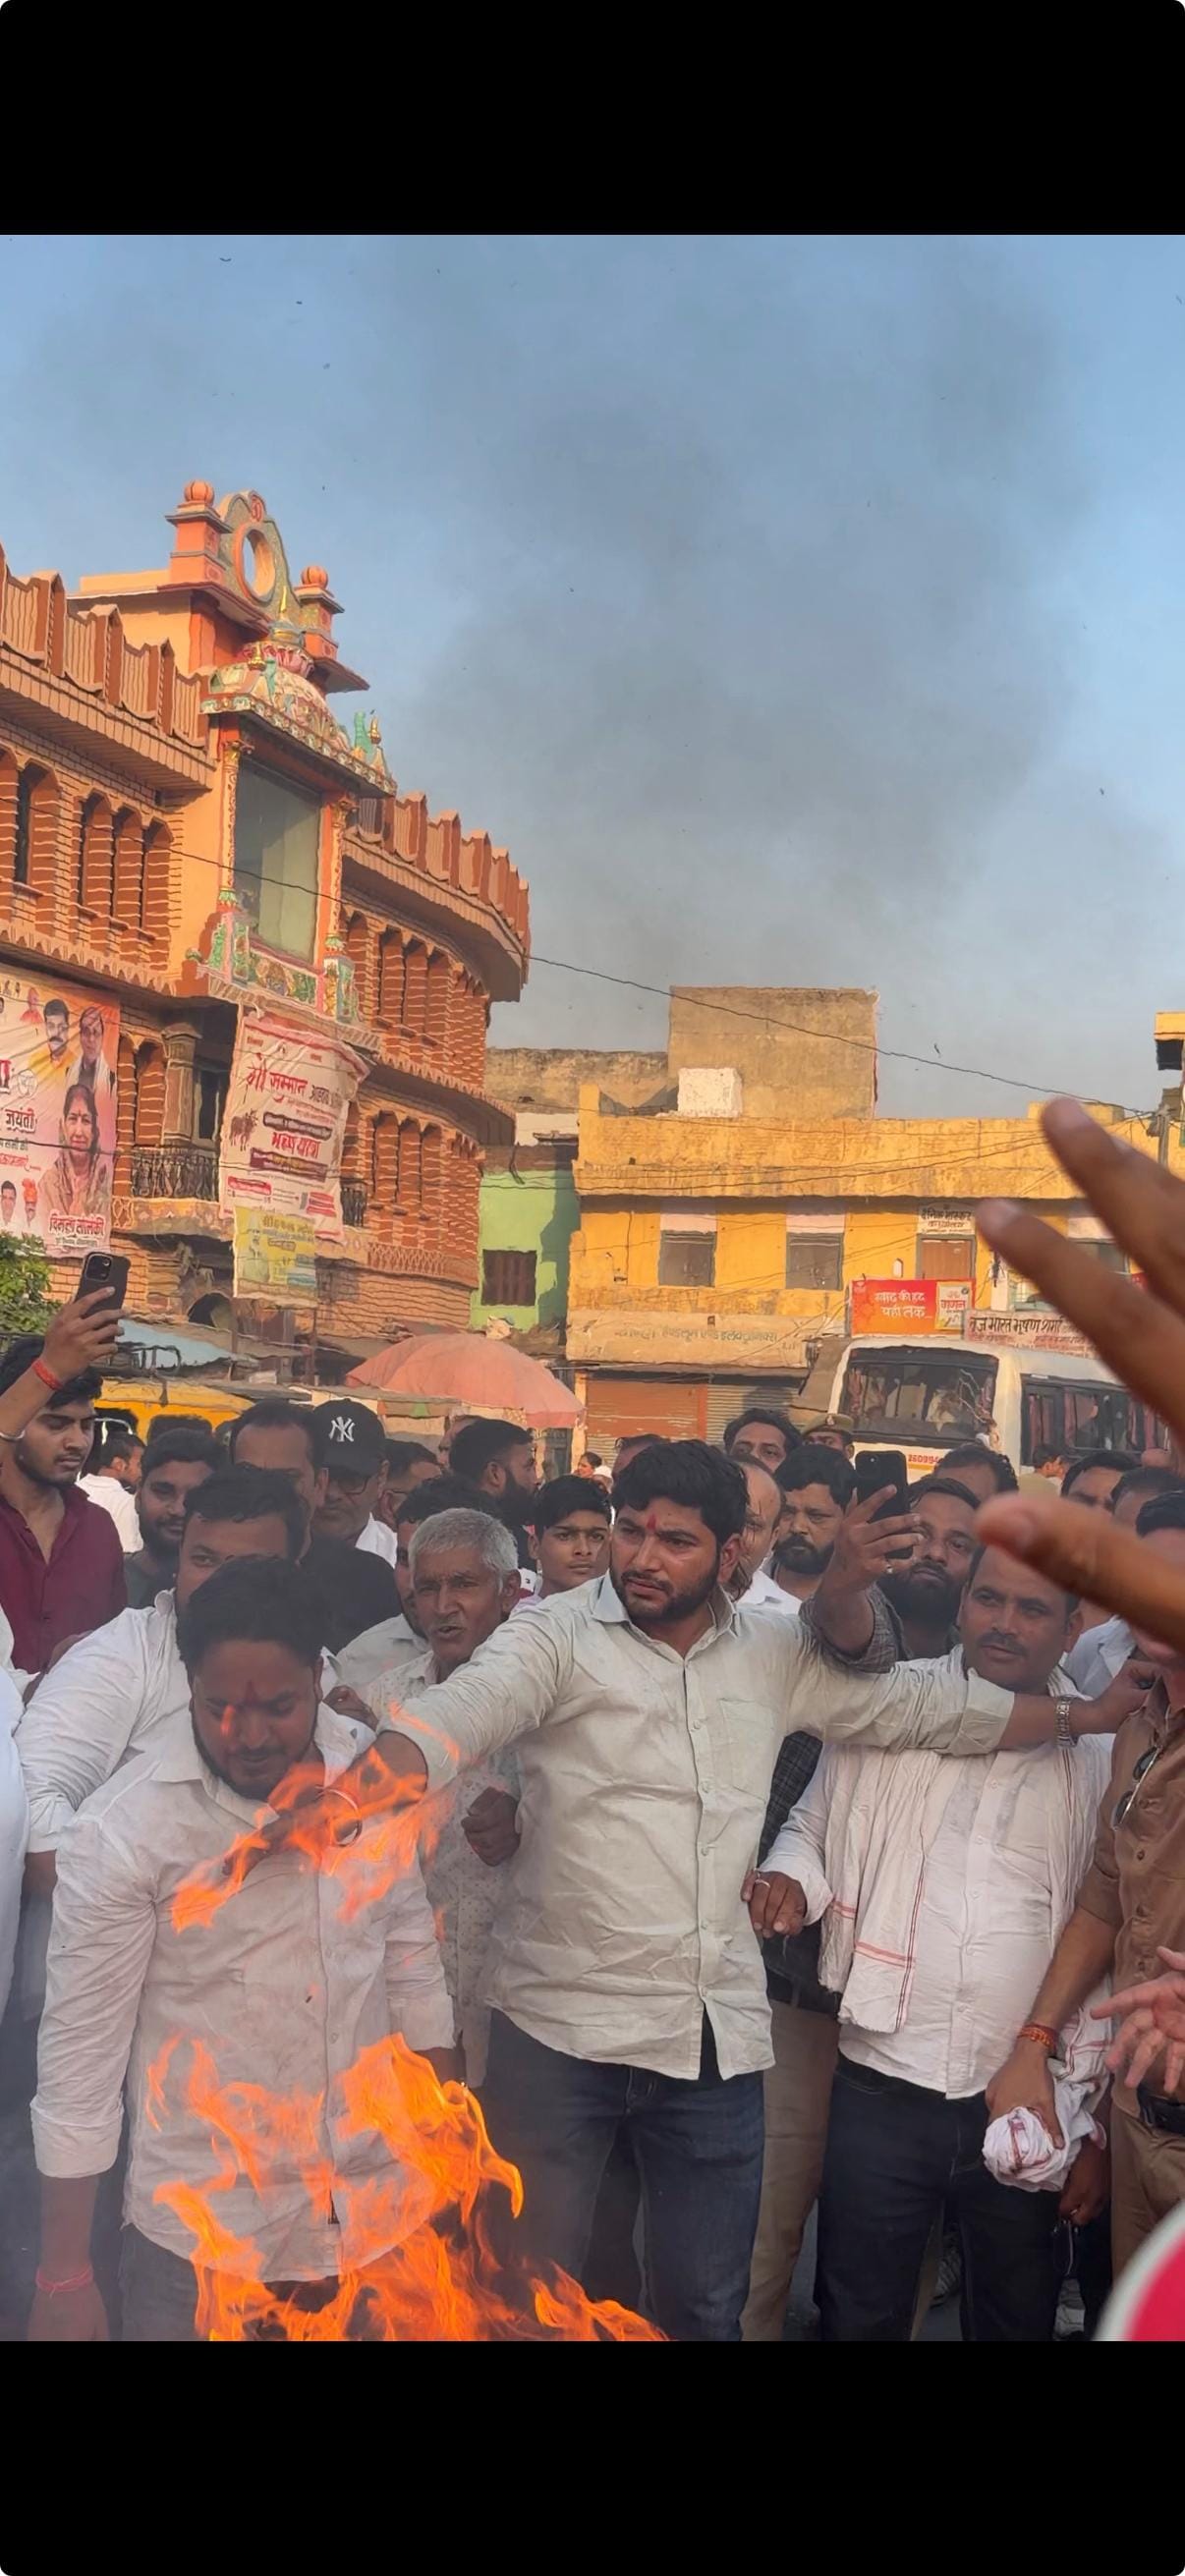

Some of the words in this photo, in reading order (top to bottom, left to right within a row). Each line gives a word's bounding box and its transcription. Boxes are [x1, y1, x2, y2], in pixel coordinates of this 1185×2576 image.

[5, 1107, 35, 1130] जयंती
[988, 1316, 1012, 1334] भारत
[1012, 1317, 1042, 1335] भूषण
[328, 1416, 355, 1442] NY
